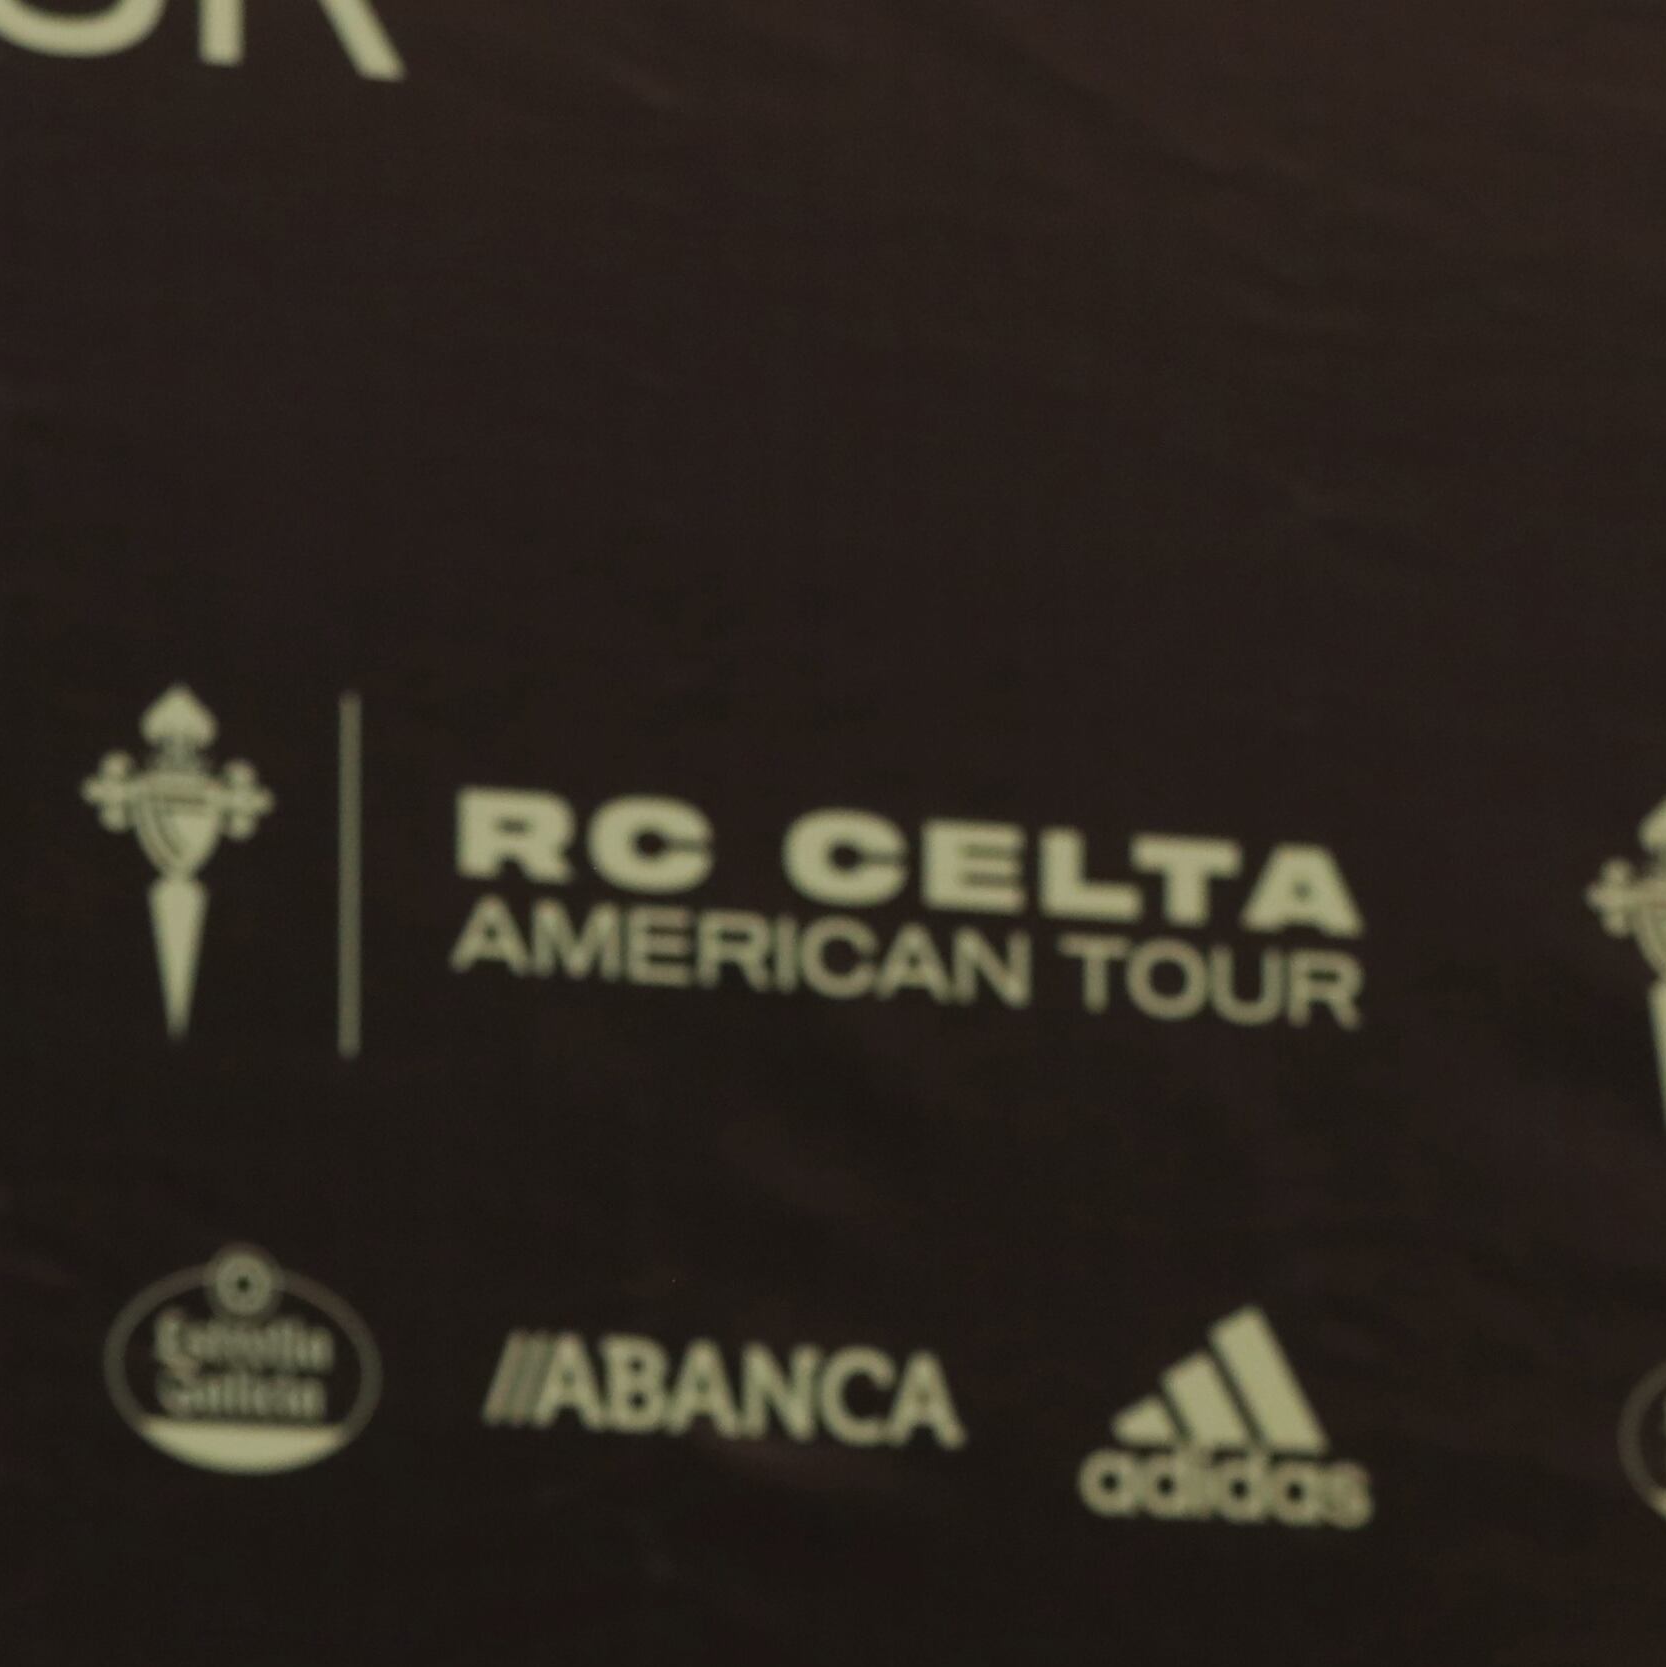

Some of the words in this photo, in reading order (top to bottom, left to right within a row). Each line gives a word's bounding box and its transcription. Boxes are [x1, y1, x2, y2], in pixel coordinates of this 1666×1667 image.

[456, 787, 714, 893] RC
[782, 809, 1363, 937] CELTA
[450, 896, 1031, 1008] AMERICAN
[1057, 934, 1363, 1030] TOUR
[1079, 1448, 1373, 1529] adidas
